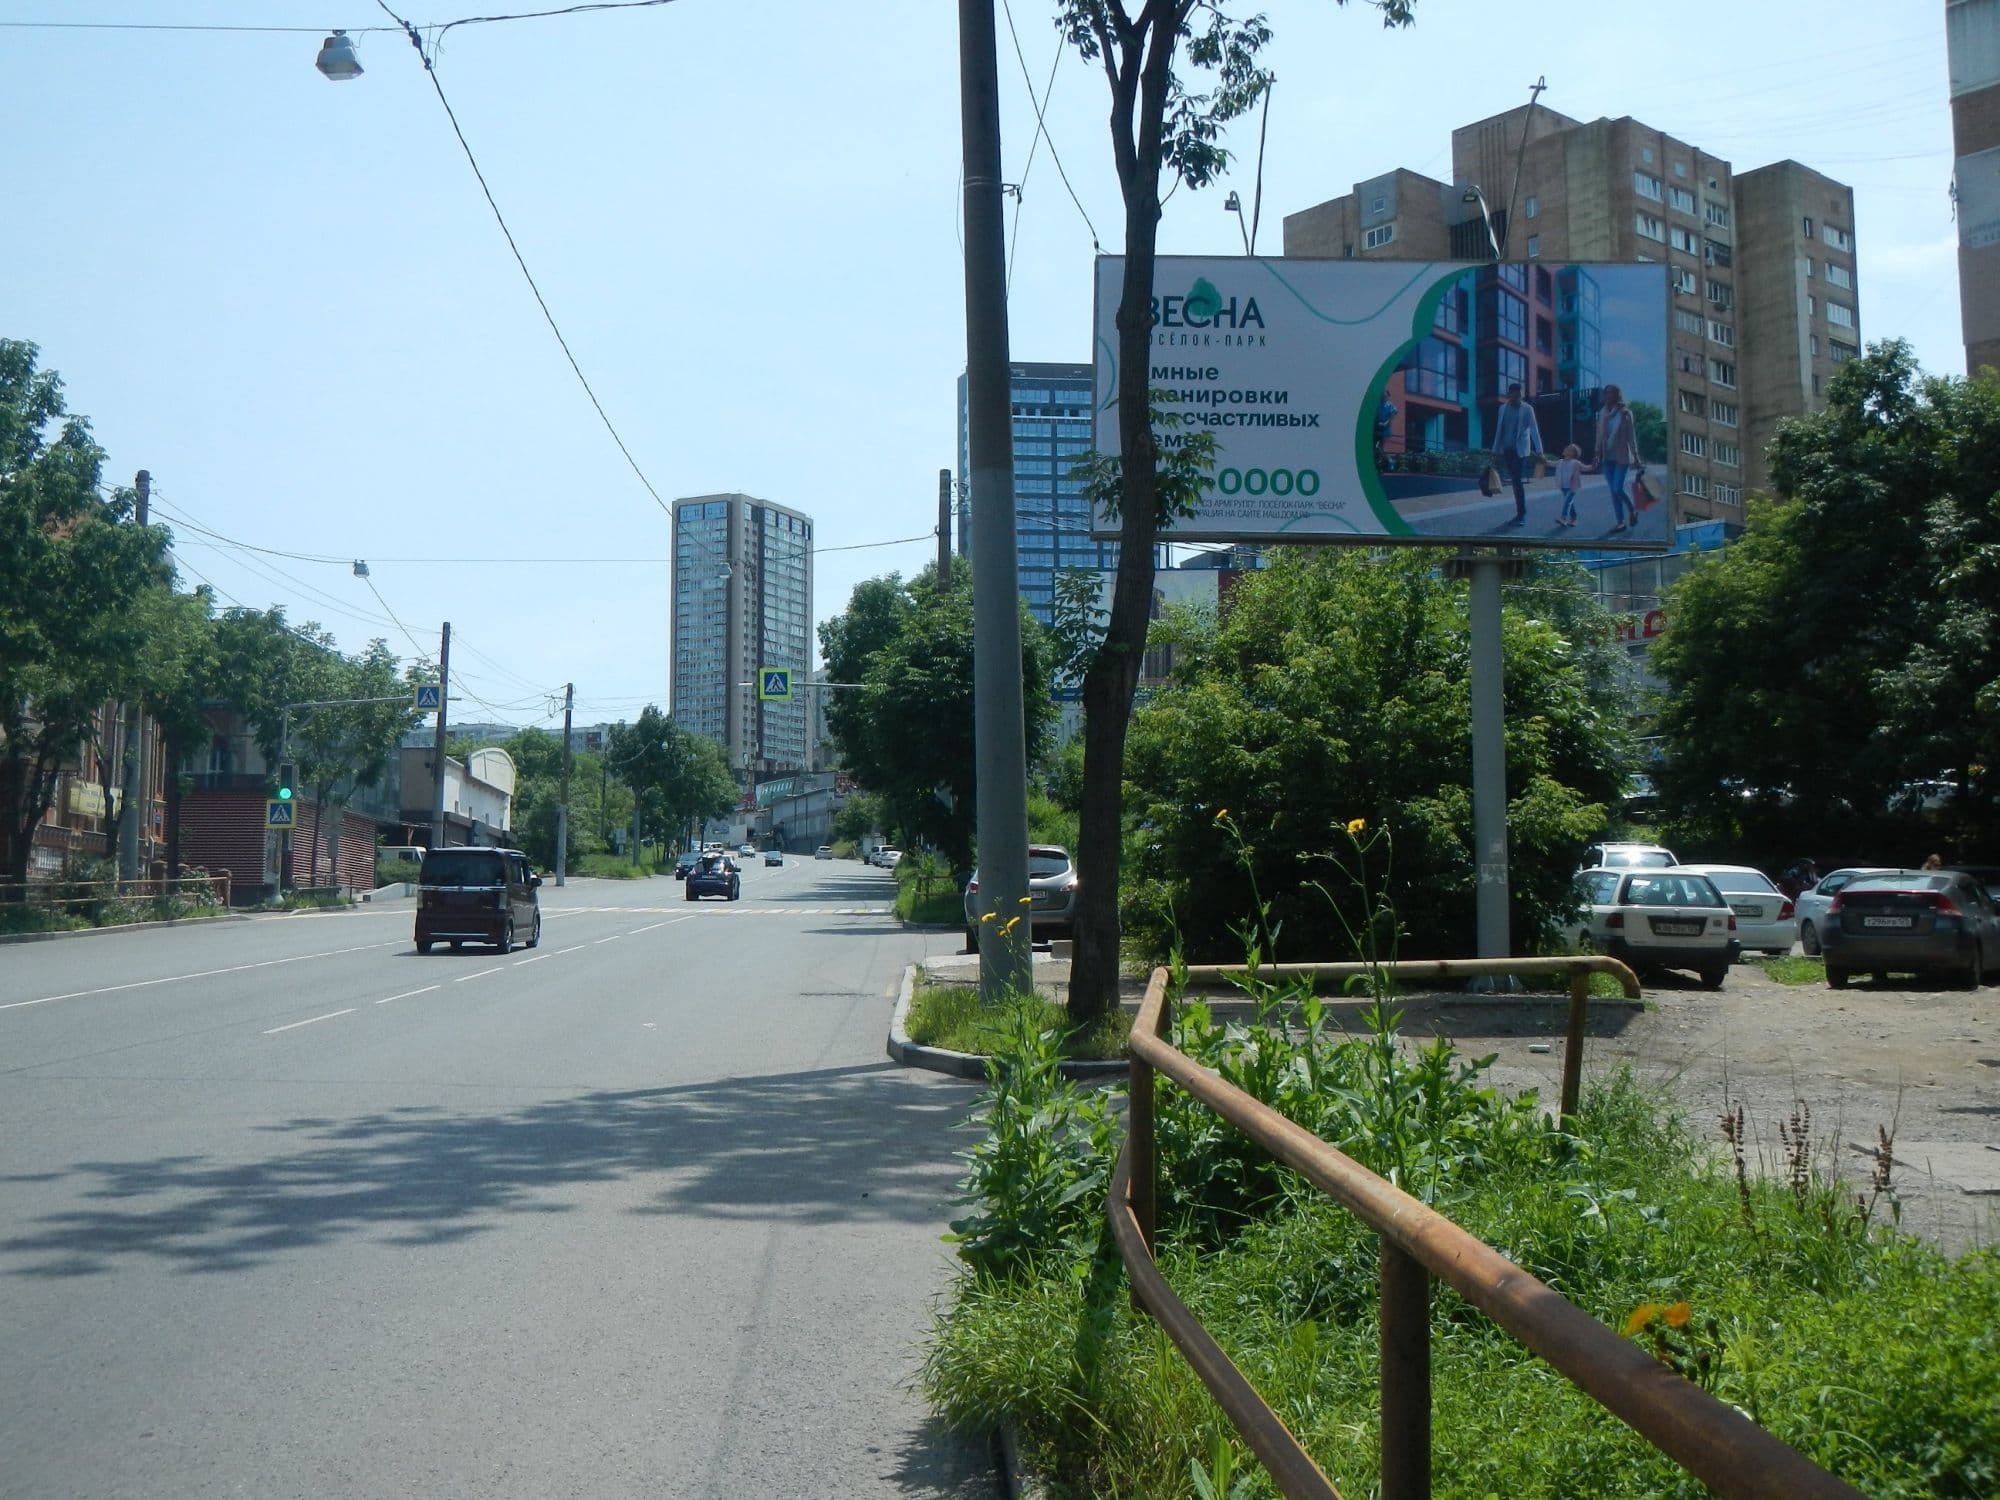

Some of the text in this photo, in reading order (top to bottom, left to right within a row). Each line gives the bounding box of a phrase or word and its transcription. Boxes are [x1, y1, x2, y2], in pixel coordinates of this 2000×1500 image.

[1149, 332, 1266, 347] СЁЛОК-ПАРК
[1151, 366, 1219, 381] мные
[1151, 388, 1289, 408] анировки
[1182, 411, 1321, 428] счастливых
